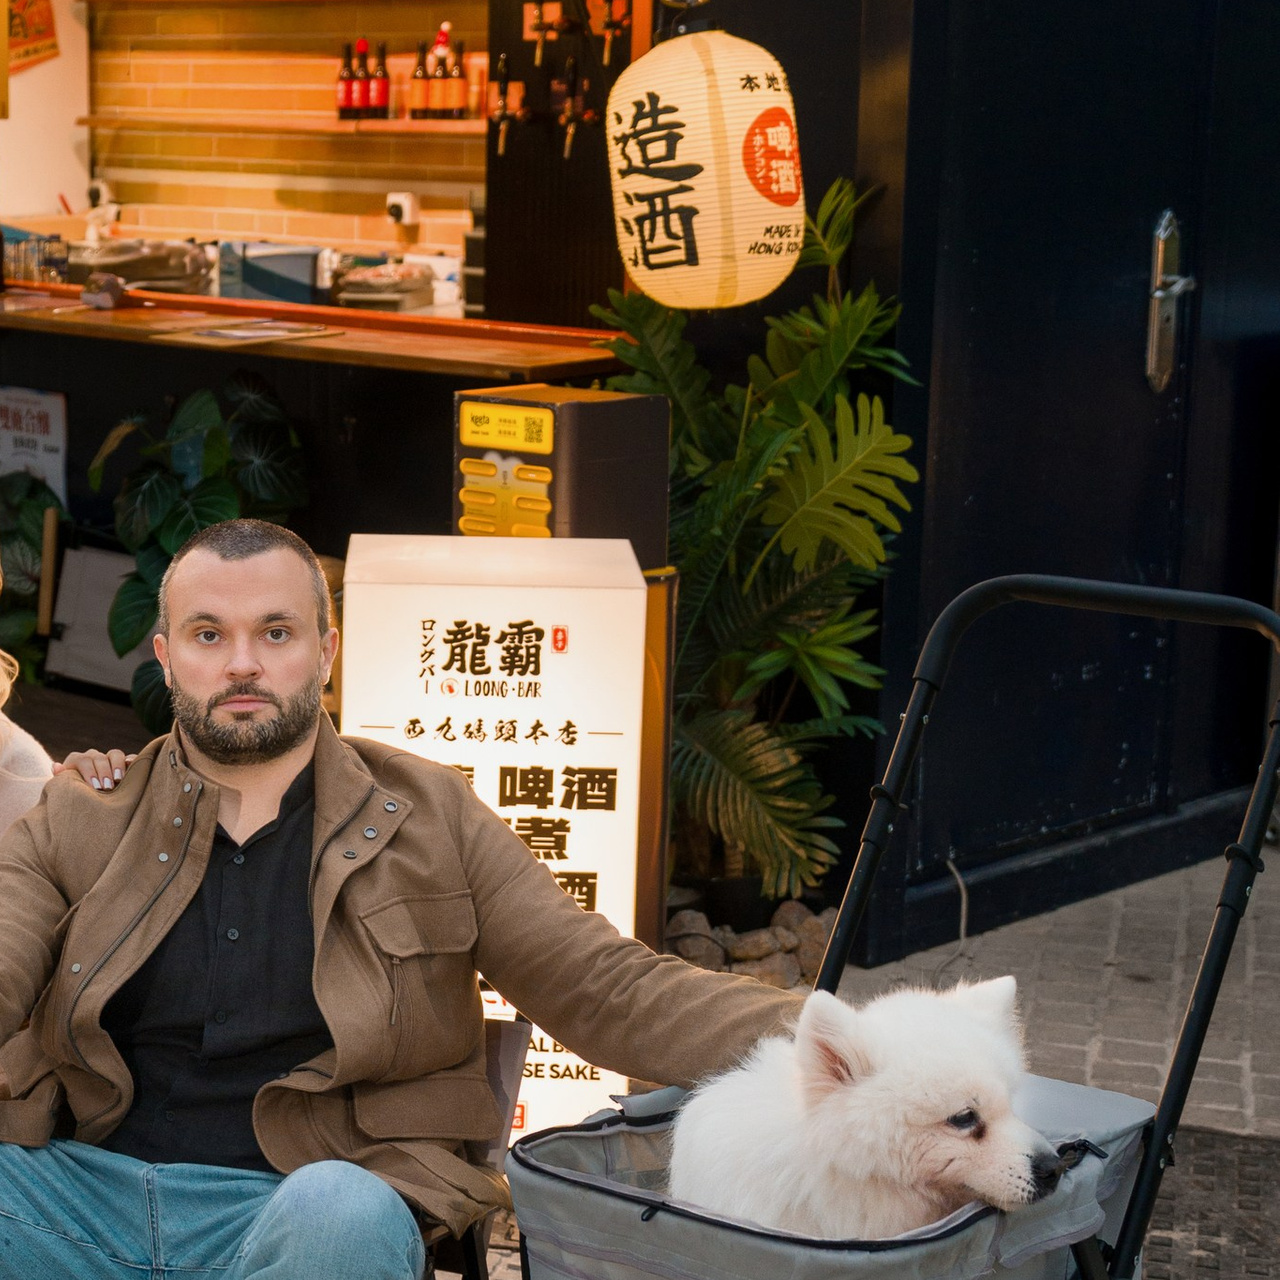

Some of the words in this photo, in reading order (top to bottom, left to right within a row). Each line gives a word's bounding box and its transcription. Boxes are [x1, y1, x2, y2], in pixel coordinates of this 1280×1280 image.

[613, 91, 705, 271] 造酒
[748, 240, 783, 255] HONG
[442, 619, 545, 677] 龍霸
[549, 1064, 601, 1081] SAKE
